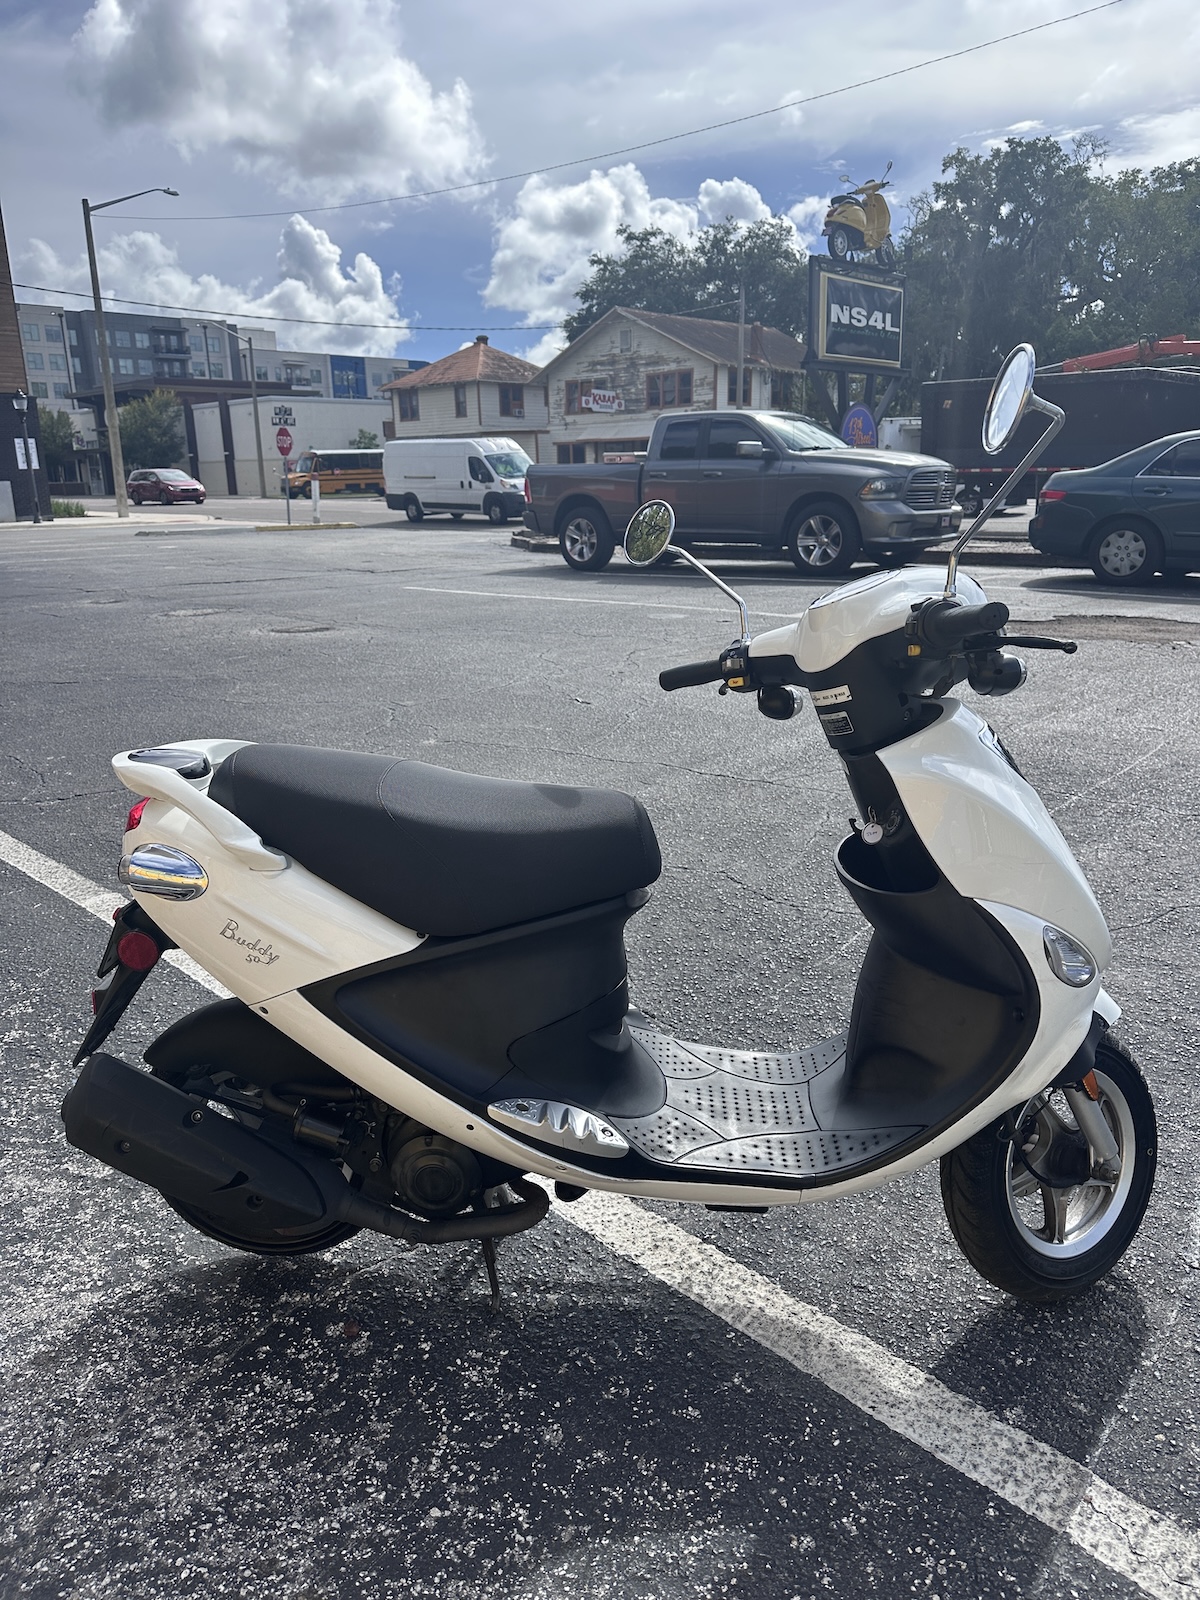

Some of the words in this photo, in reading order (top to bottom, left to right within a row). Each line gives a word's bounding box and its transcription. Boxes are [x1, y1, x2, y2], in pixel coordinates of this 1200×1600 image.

[830, 303, 900, 333] NS4L
[277, 435, 291, 448] STOP
[219, 917, 280, 966] Buddy
[245, 953, 261, 964] 50
